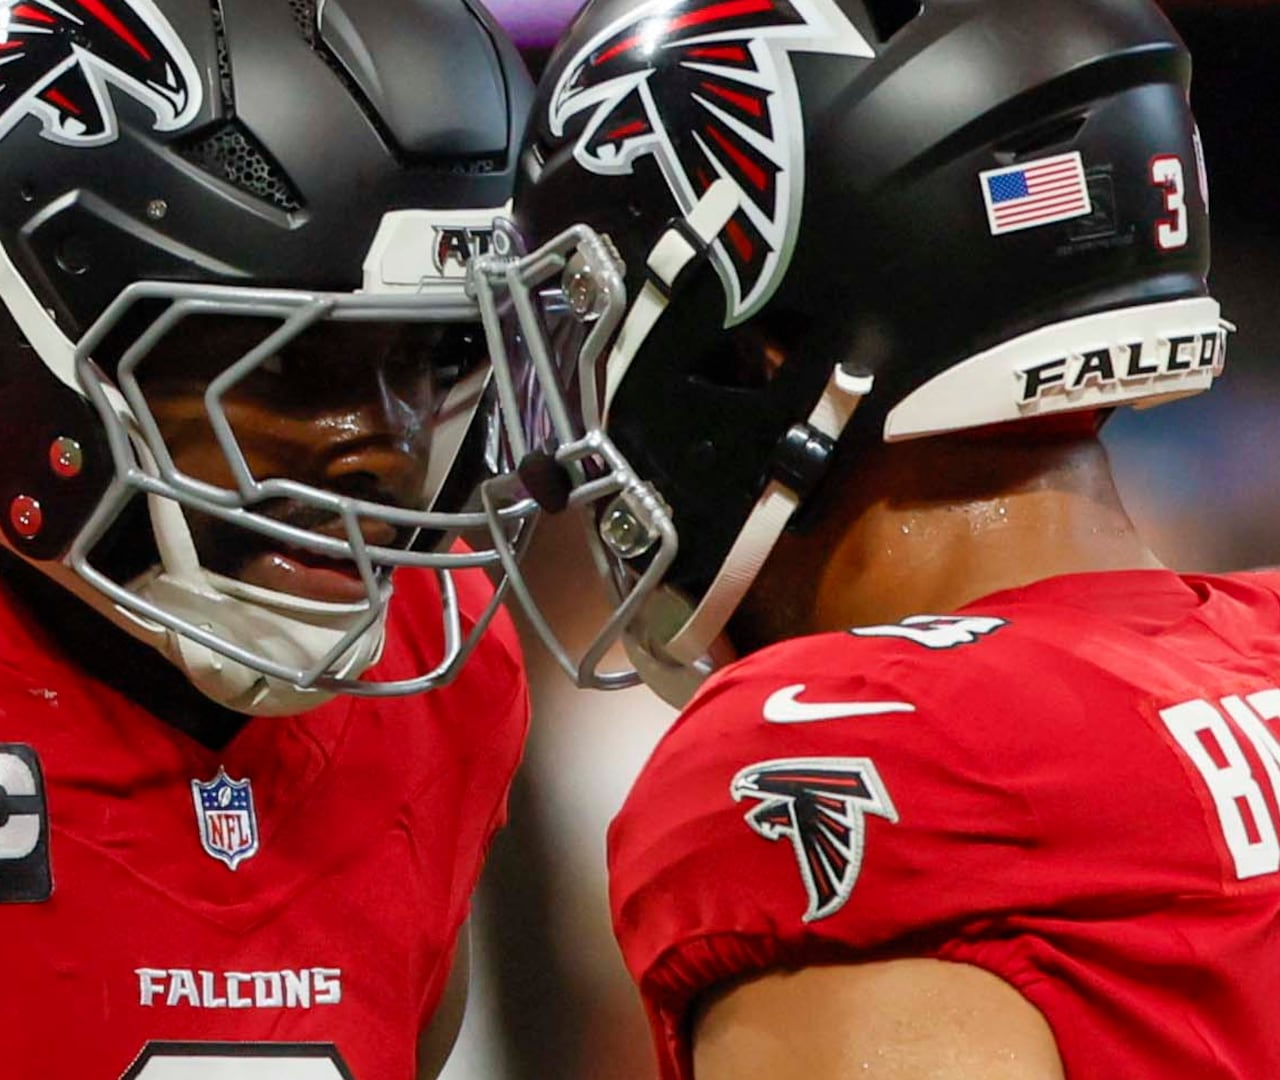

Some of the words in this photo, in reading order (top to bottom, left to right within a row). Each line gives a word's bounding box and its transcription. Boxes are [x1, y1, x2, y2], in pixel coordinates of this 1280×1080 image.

[1147, 154, 1189, 251] 3
[207, 812, 251, 852] NFL
[135, 967, 342, 1010] FALCONS
